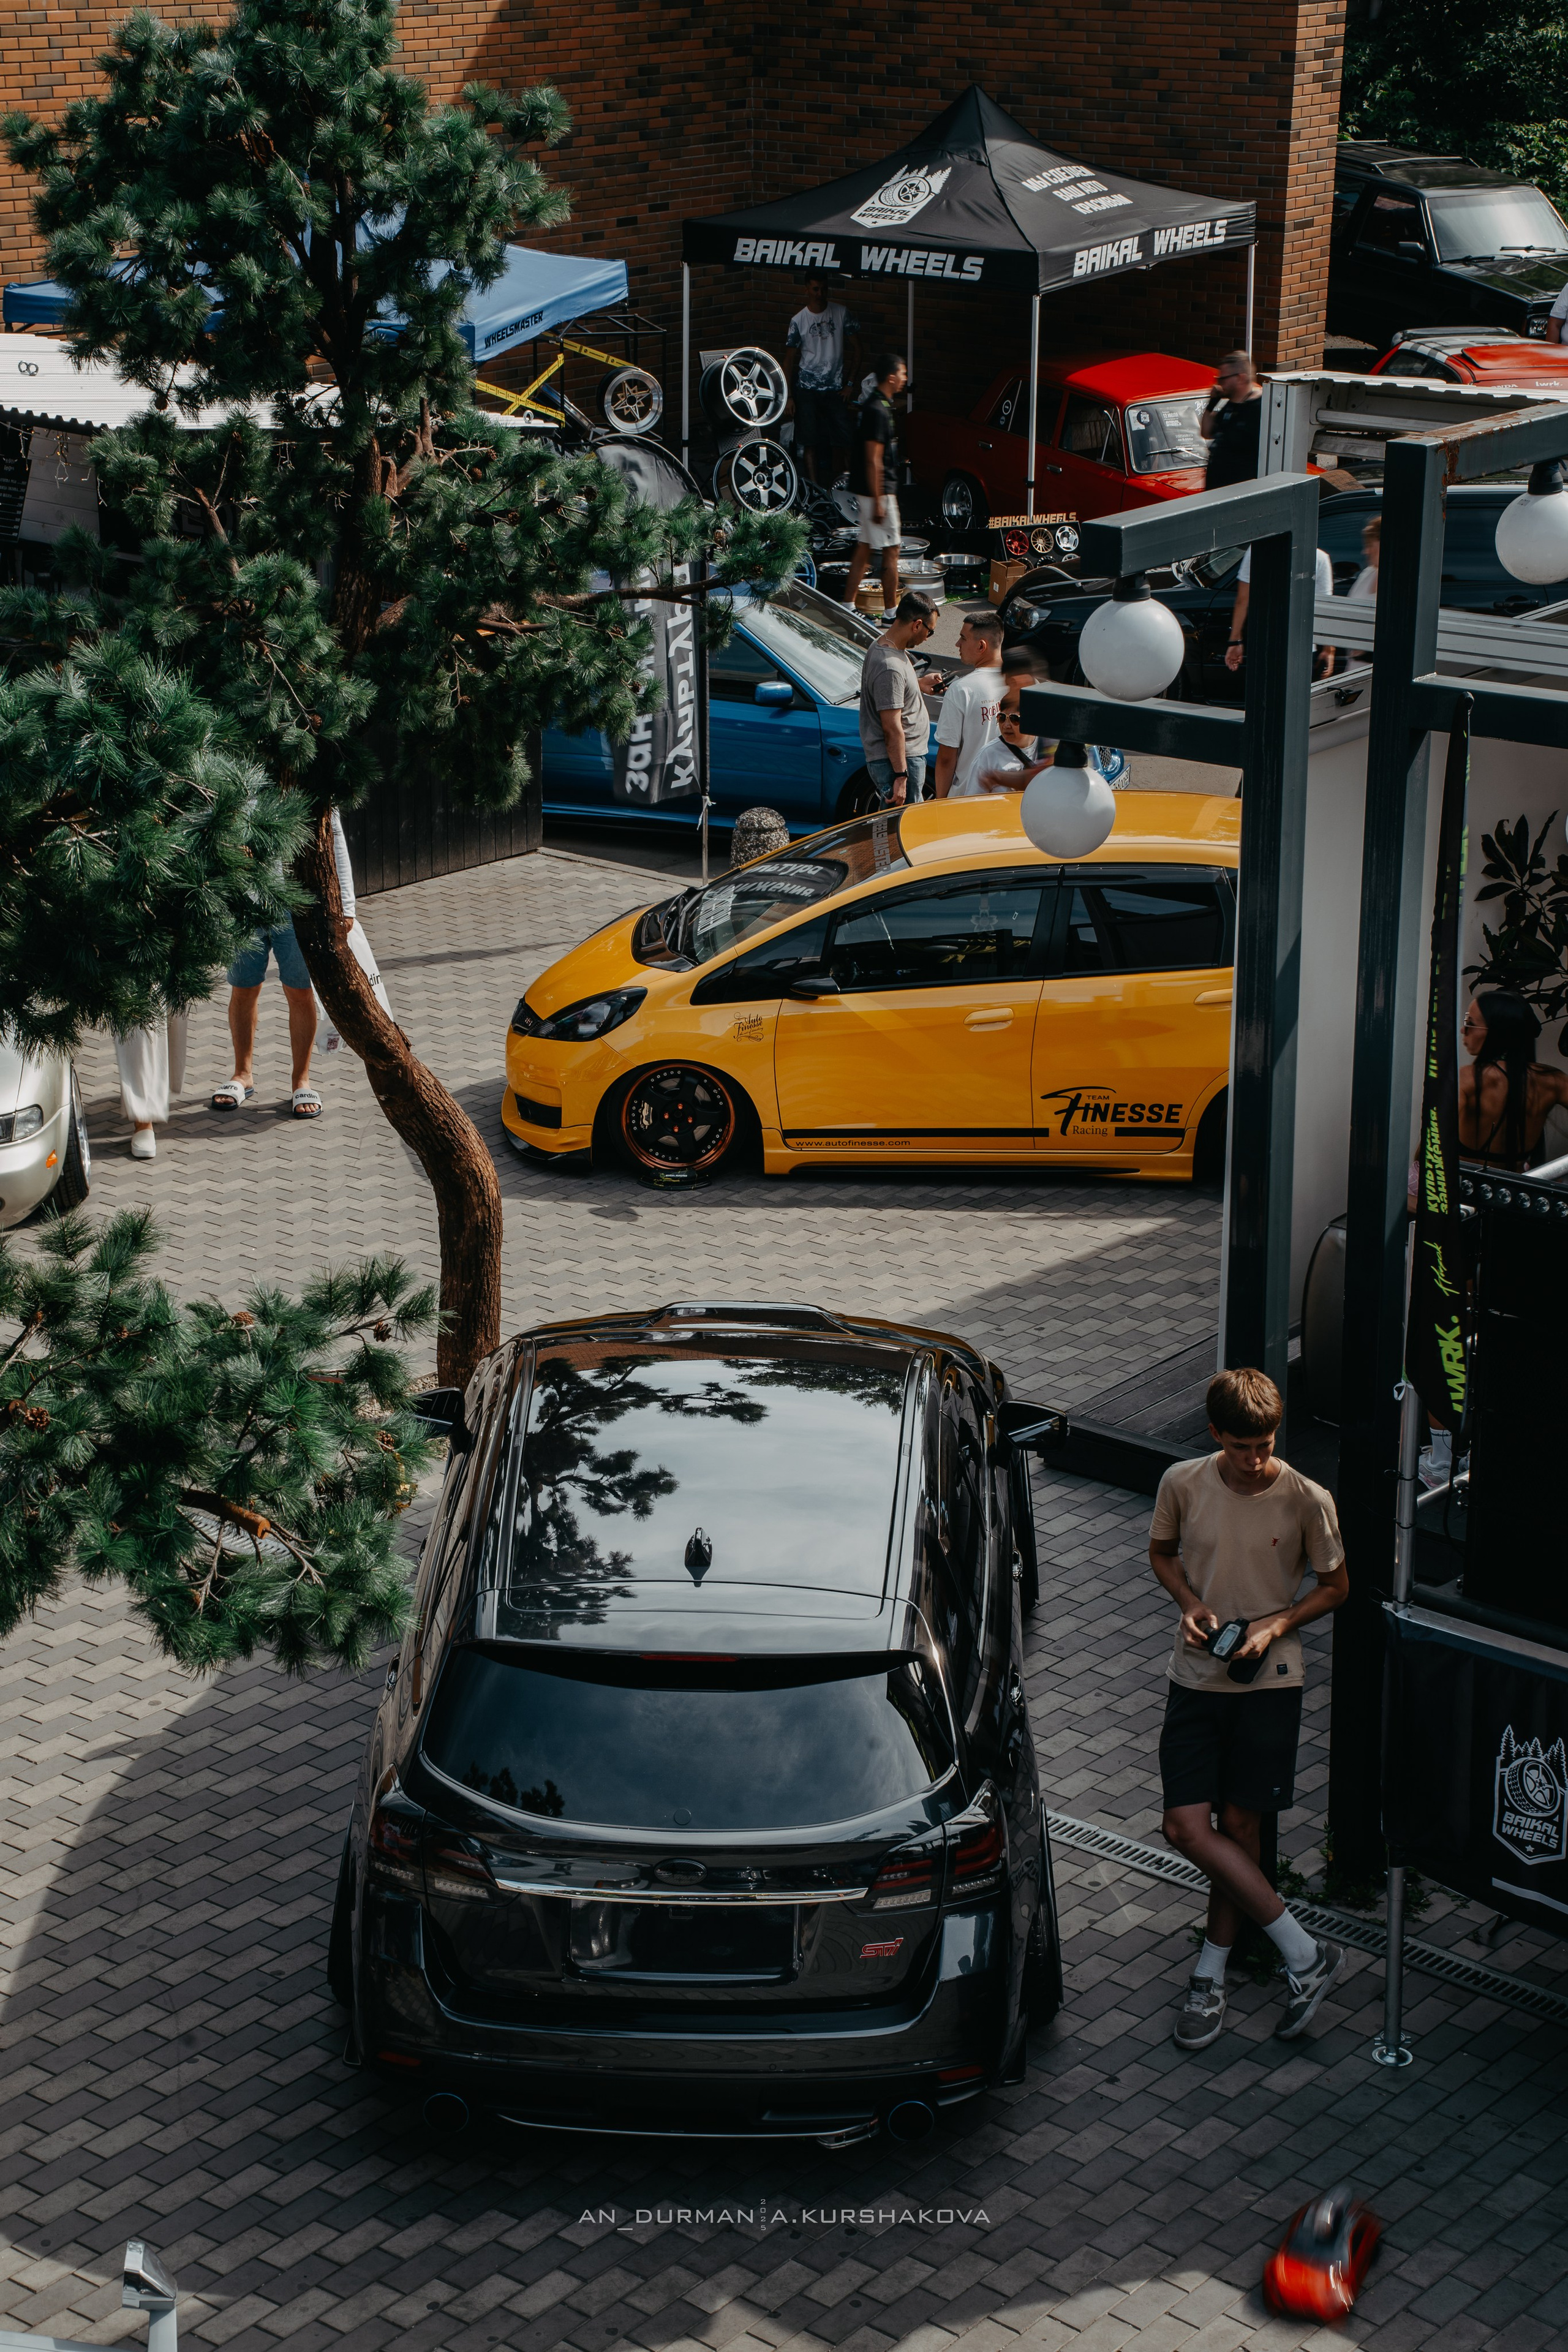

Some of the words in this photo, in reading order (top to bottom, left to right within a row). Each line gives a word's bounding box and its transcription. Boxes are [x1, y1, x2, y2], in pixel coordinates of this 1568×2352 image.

[1021, 175, 1052, 192] МЫ
[1042, 165, 1096, 184] СДЕЛАЕМ
[1052, 185, 1086, 202] ВАШ
[1076, 180, 1109, 195] АВТО
[857, 212, 907, 221] WHEELS
[863, 206, 911, 216] BAIKAL
[1071, 194, 1134, 215] КРАСИВЫМ
[733, 238, 841, 268] BAIKAL
[861, 245, 985, 282] WHEELS
[1072, 236, 1144, 278] BAIKAL
[1153, 219, 1228, 256] WHEELS
[484, 309, 544, 350] WHEELSMASTER
[1072, 1125, 1108, 1136] Racing
[1502, 1811, 1559, 1839] BAIKAL
[1502, 1823, 1558, 1849] WHEELS
